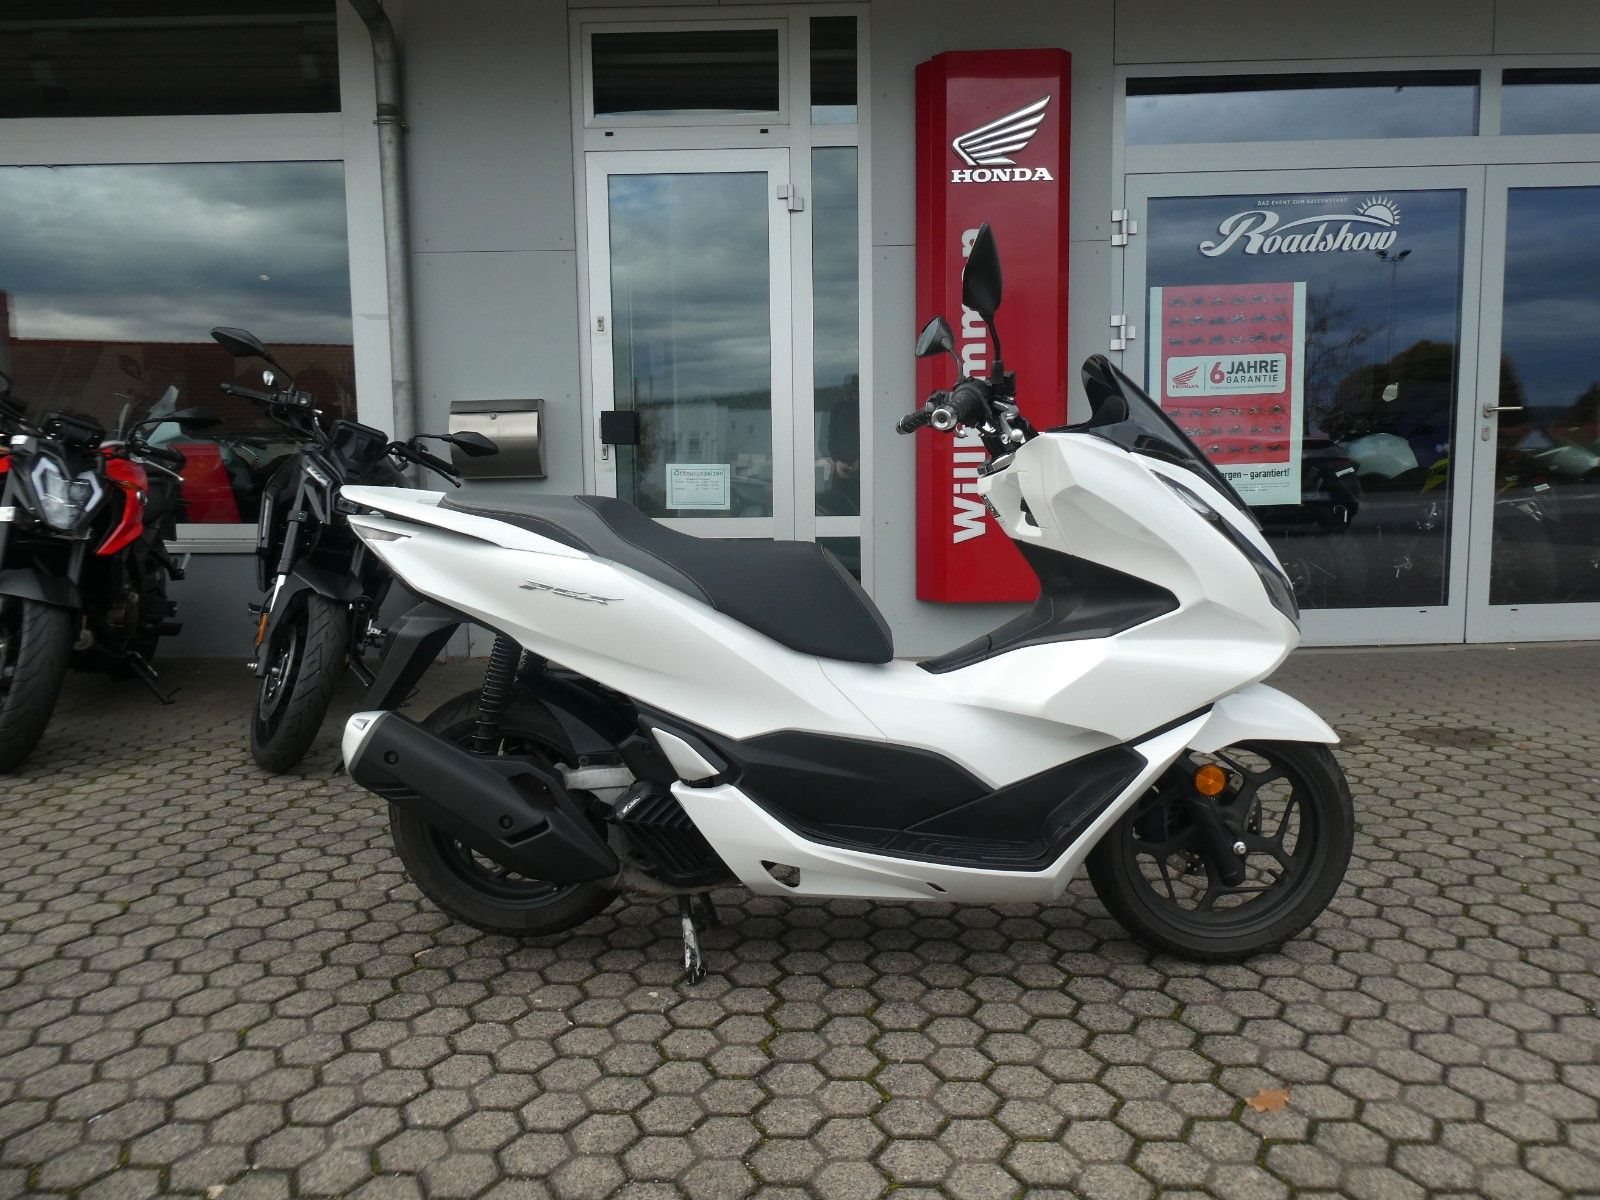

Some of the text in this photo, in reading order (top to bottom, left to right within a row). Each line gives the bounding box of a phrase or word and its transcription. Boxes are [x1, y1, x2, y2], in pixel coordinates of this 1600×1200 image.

[951, 168, 1054, 183] HONDA
[1200, 210, 1397, 257] Roadshow
[1210, 361, 1225, 384] 6
[1226, 374, 1278, 384] GARANTIE
